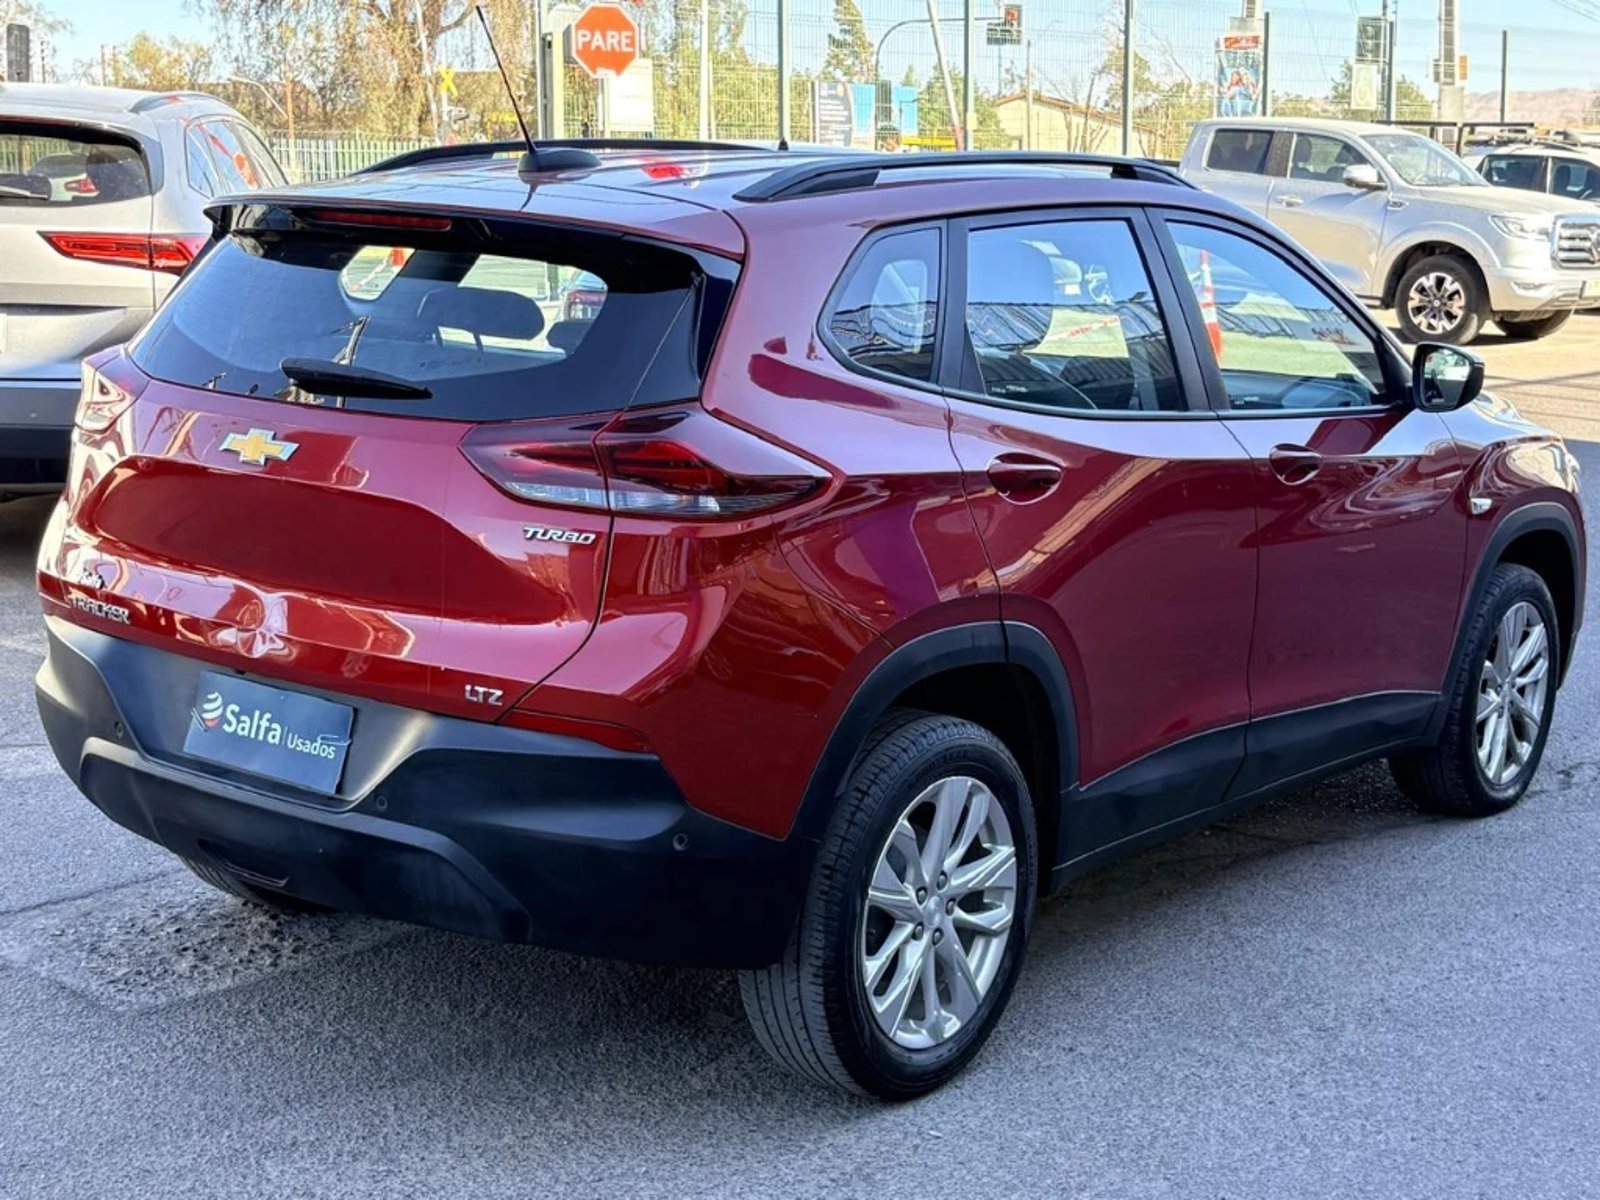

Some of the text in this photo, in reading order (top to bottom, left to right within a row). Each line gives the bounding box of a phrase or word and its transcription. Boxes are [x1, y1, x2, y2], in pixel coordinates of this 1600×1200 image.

[577, 30, 634, 52] PARE
[524, 526, 596, 545] TURBO
[71, 596, 130, 625] TRACKER
[464, 684, 504, 706] LTZ
[223, 703, 337, 759] Salfa Usados
